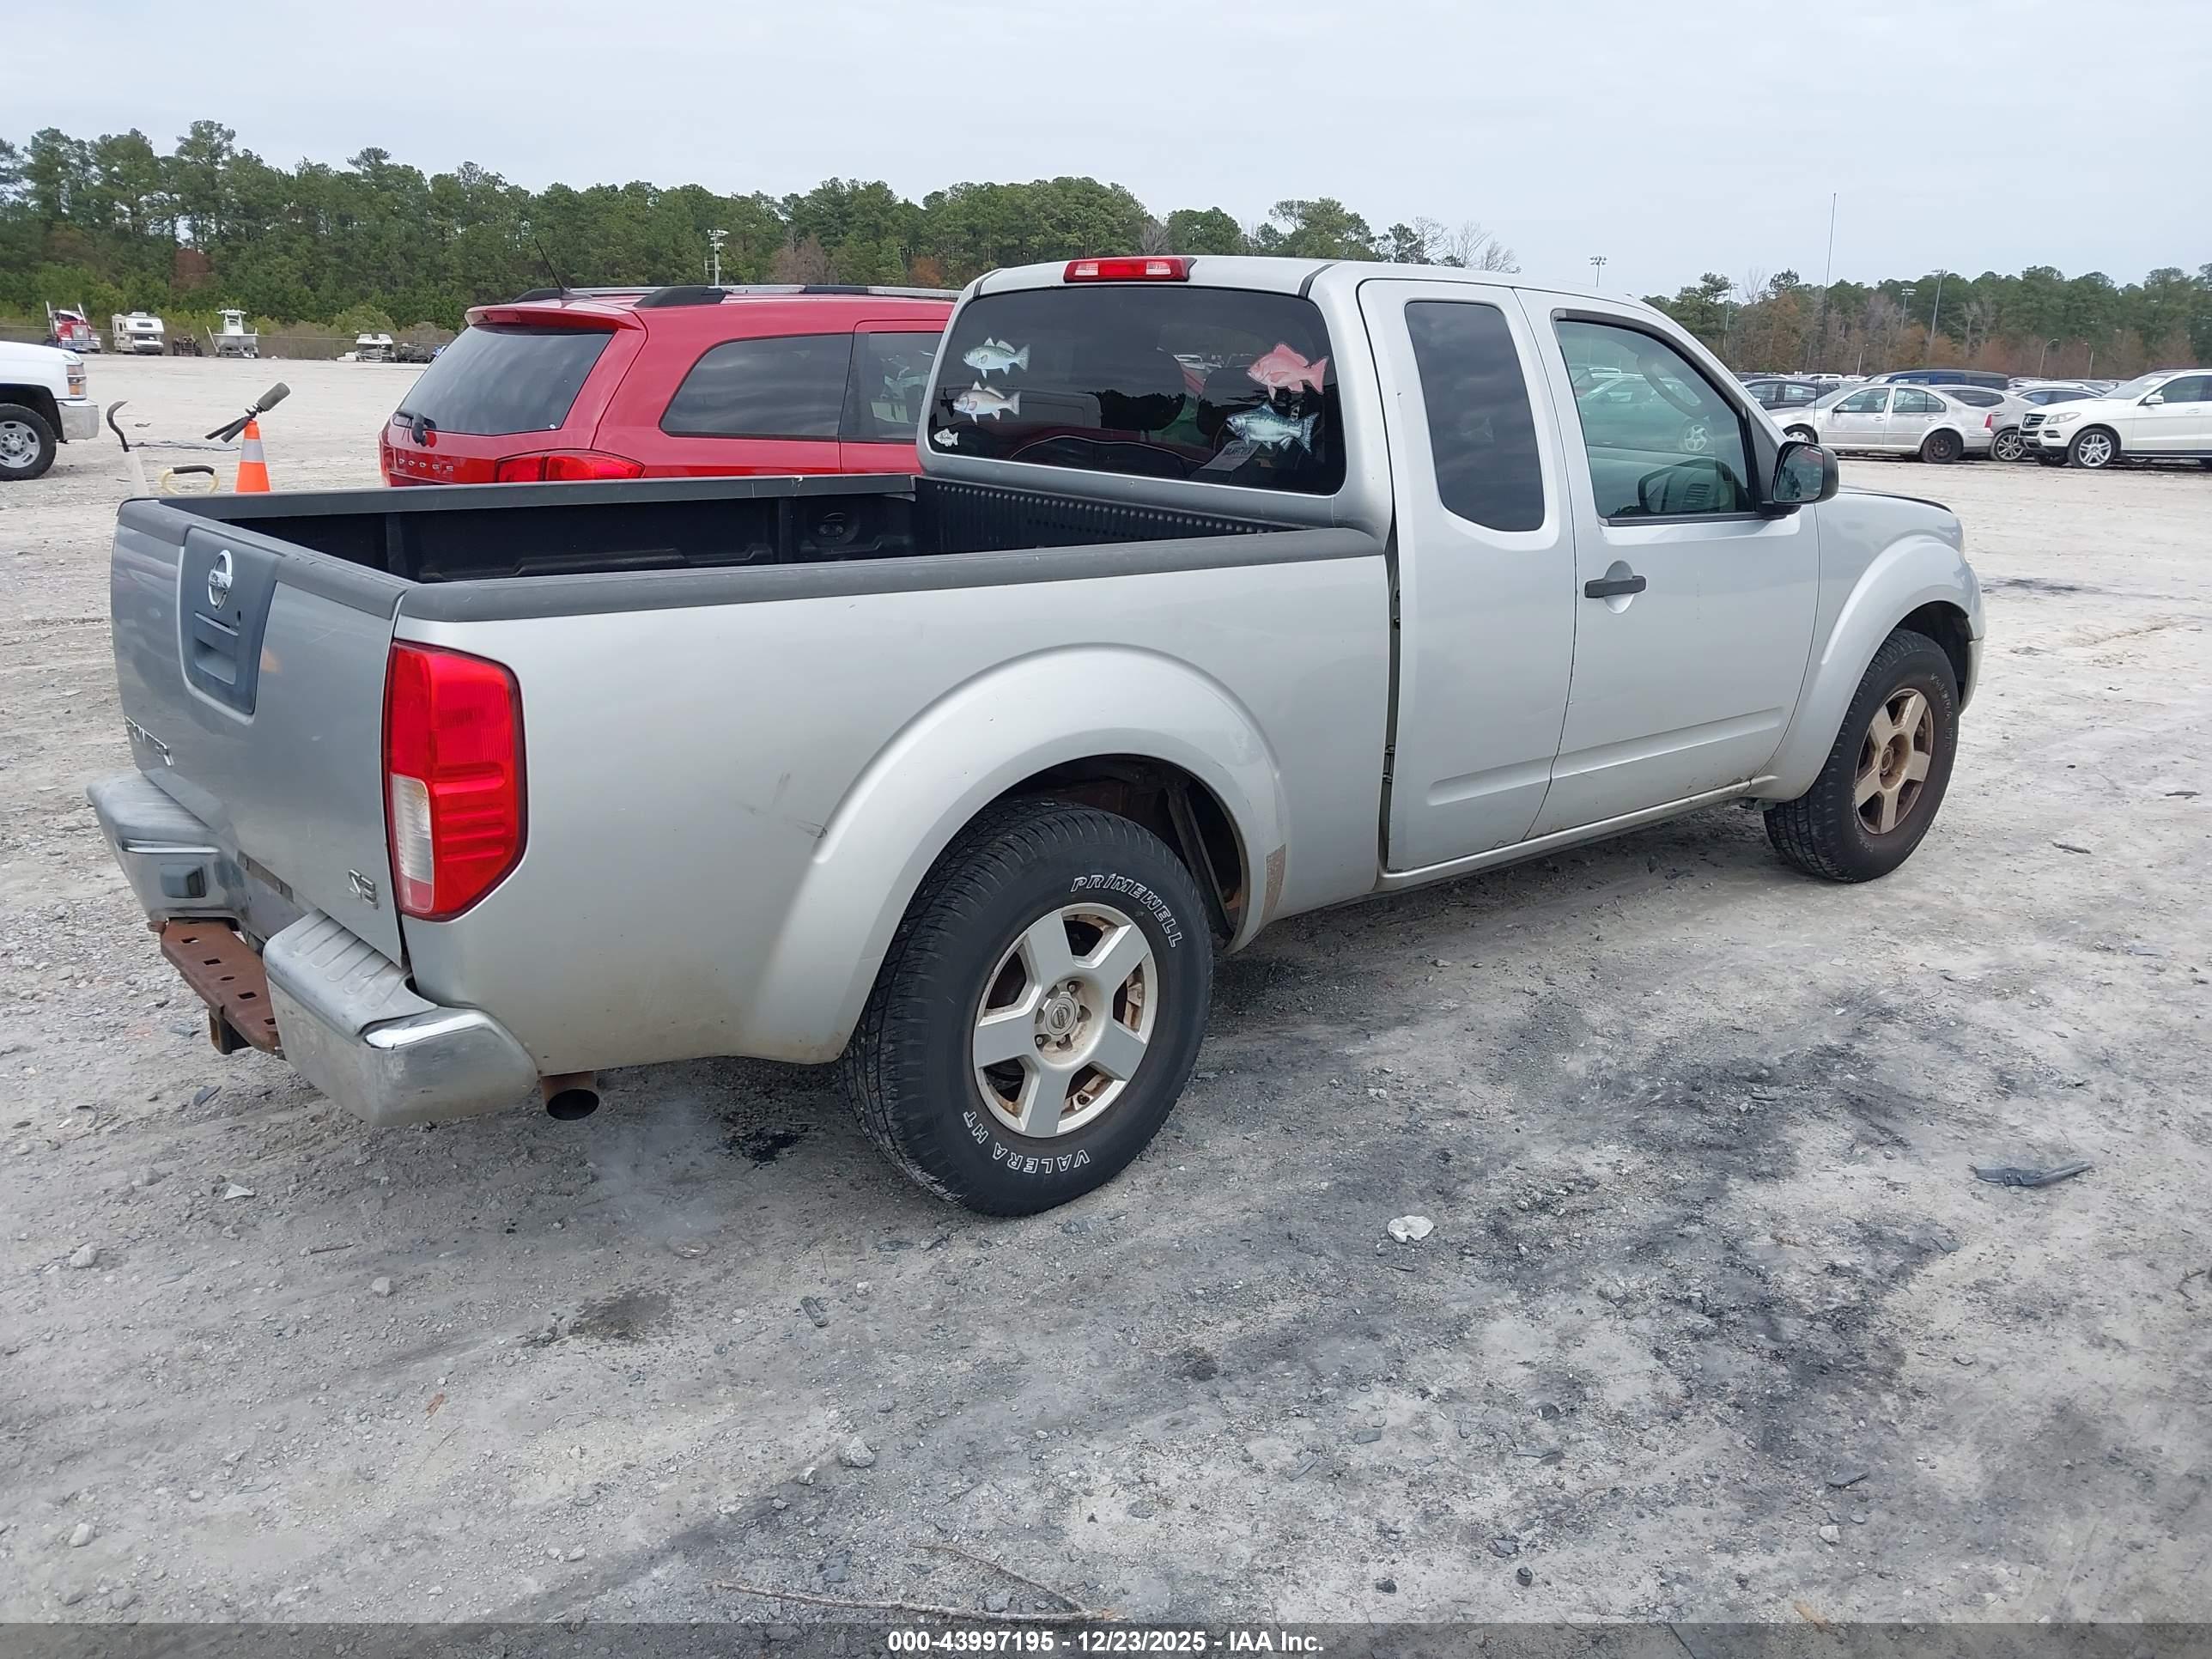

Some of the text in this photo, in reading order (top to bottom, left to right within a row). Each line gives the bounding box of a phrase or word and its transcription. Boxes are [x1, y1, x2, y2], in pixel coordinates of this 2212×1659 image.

[398, 458, 454, 472] DODGE
[348, 868, 379, 910] SE
[1070, 872, 1183, 948] PRIMEWELL
[963, 1110, 1091, 1174] VALERA HT
